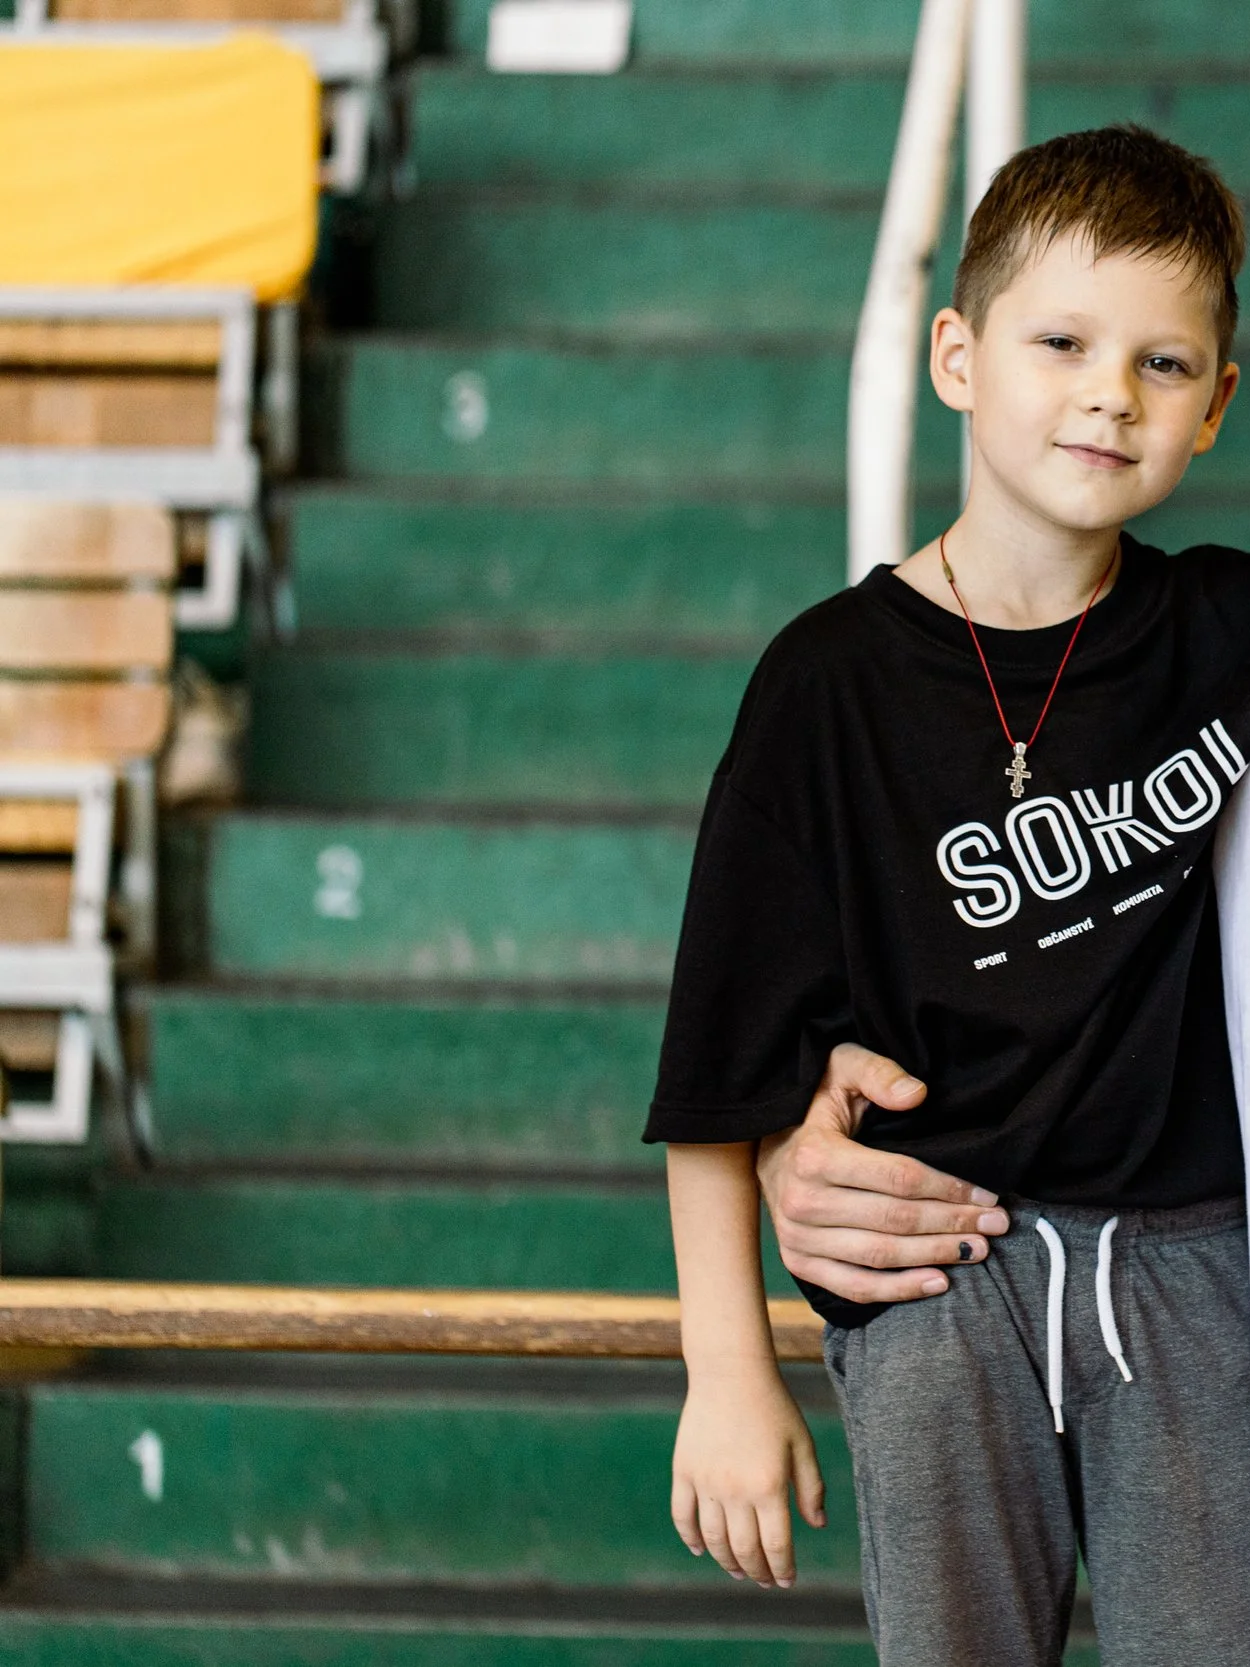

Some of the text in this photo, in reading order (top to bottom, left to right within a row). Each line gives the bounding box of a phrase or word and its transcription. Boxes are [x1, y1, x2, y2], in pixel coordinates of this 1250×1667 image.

[936, 718, 1248, 928] SOKOL
[974, 884, 1164, 970] SPORT OBČANSTVÍ KOMUNITA
[128, 1429, 163, 1502] 1
